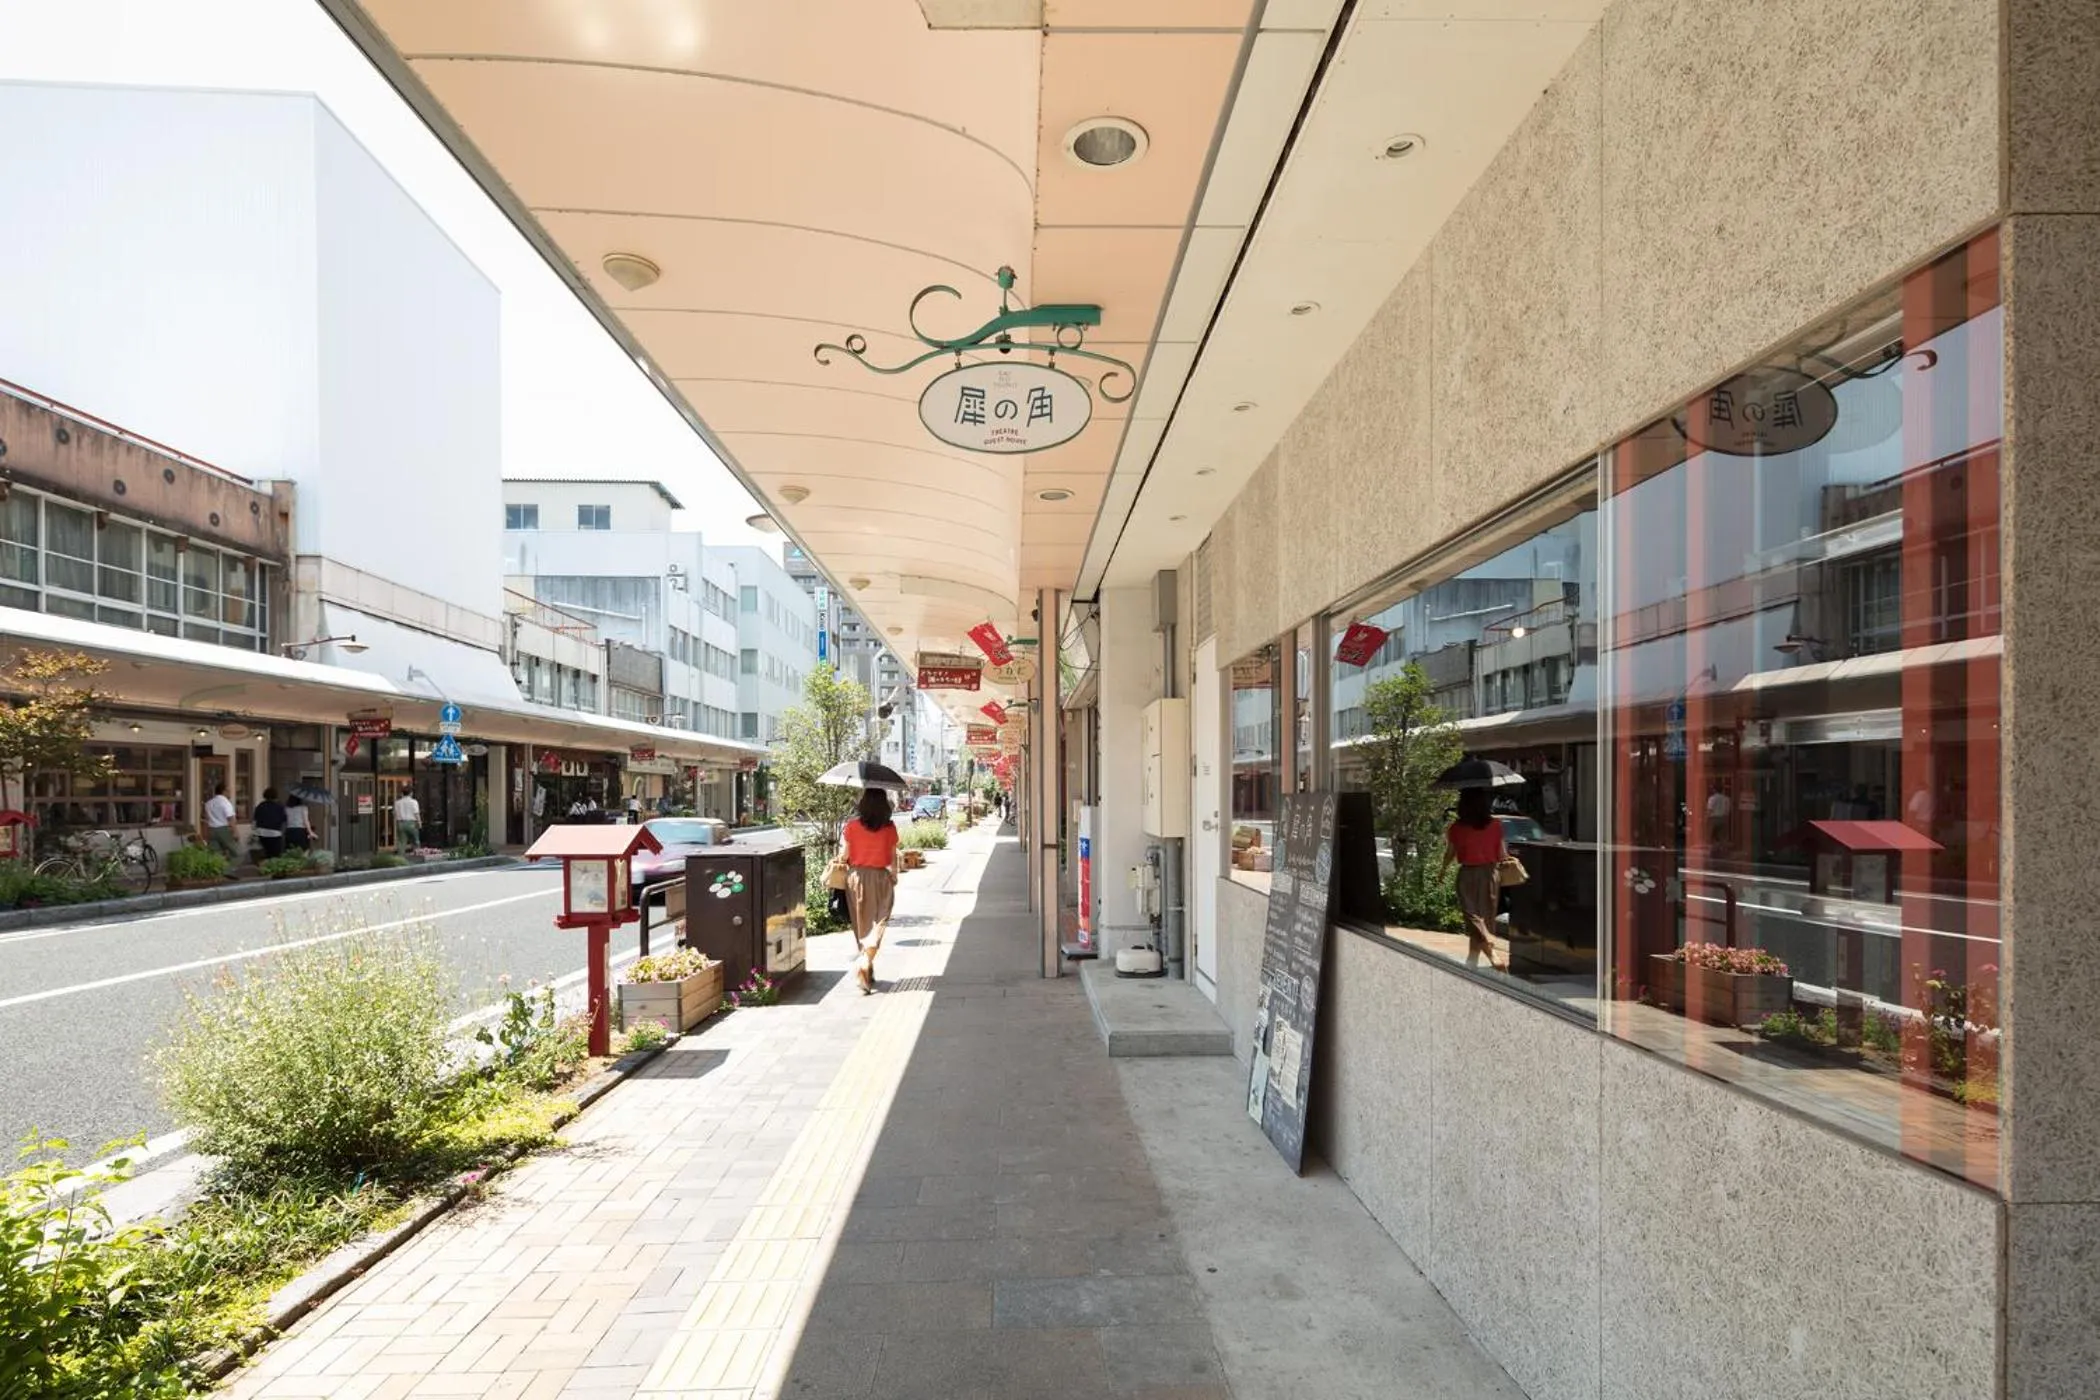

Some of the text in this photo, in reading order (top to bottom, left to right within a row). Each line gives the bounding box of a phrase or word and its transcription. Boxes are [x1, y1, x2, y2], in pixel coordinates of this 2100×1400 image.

[954, 386, 1053, 428] 犀の角
[991, 428, 1018, 436] THEATRE
